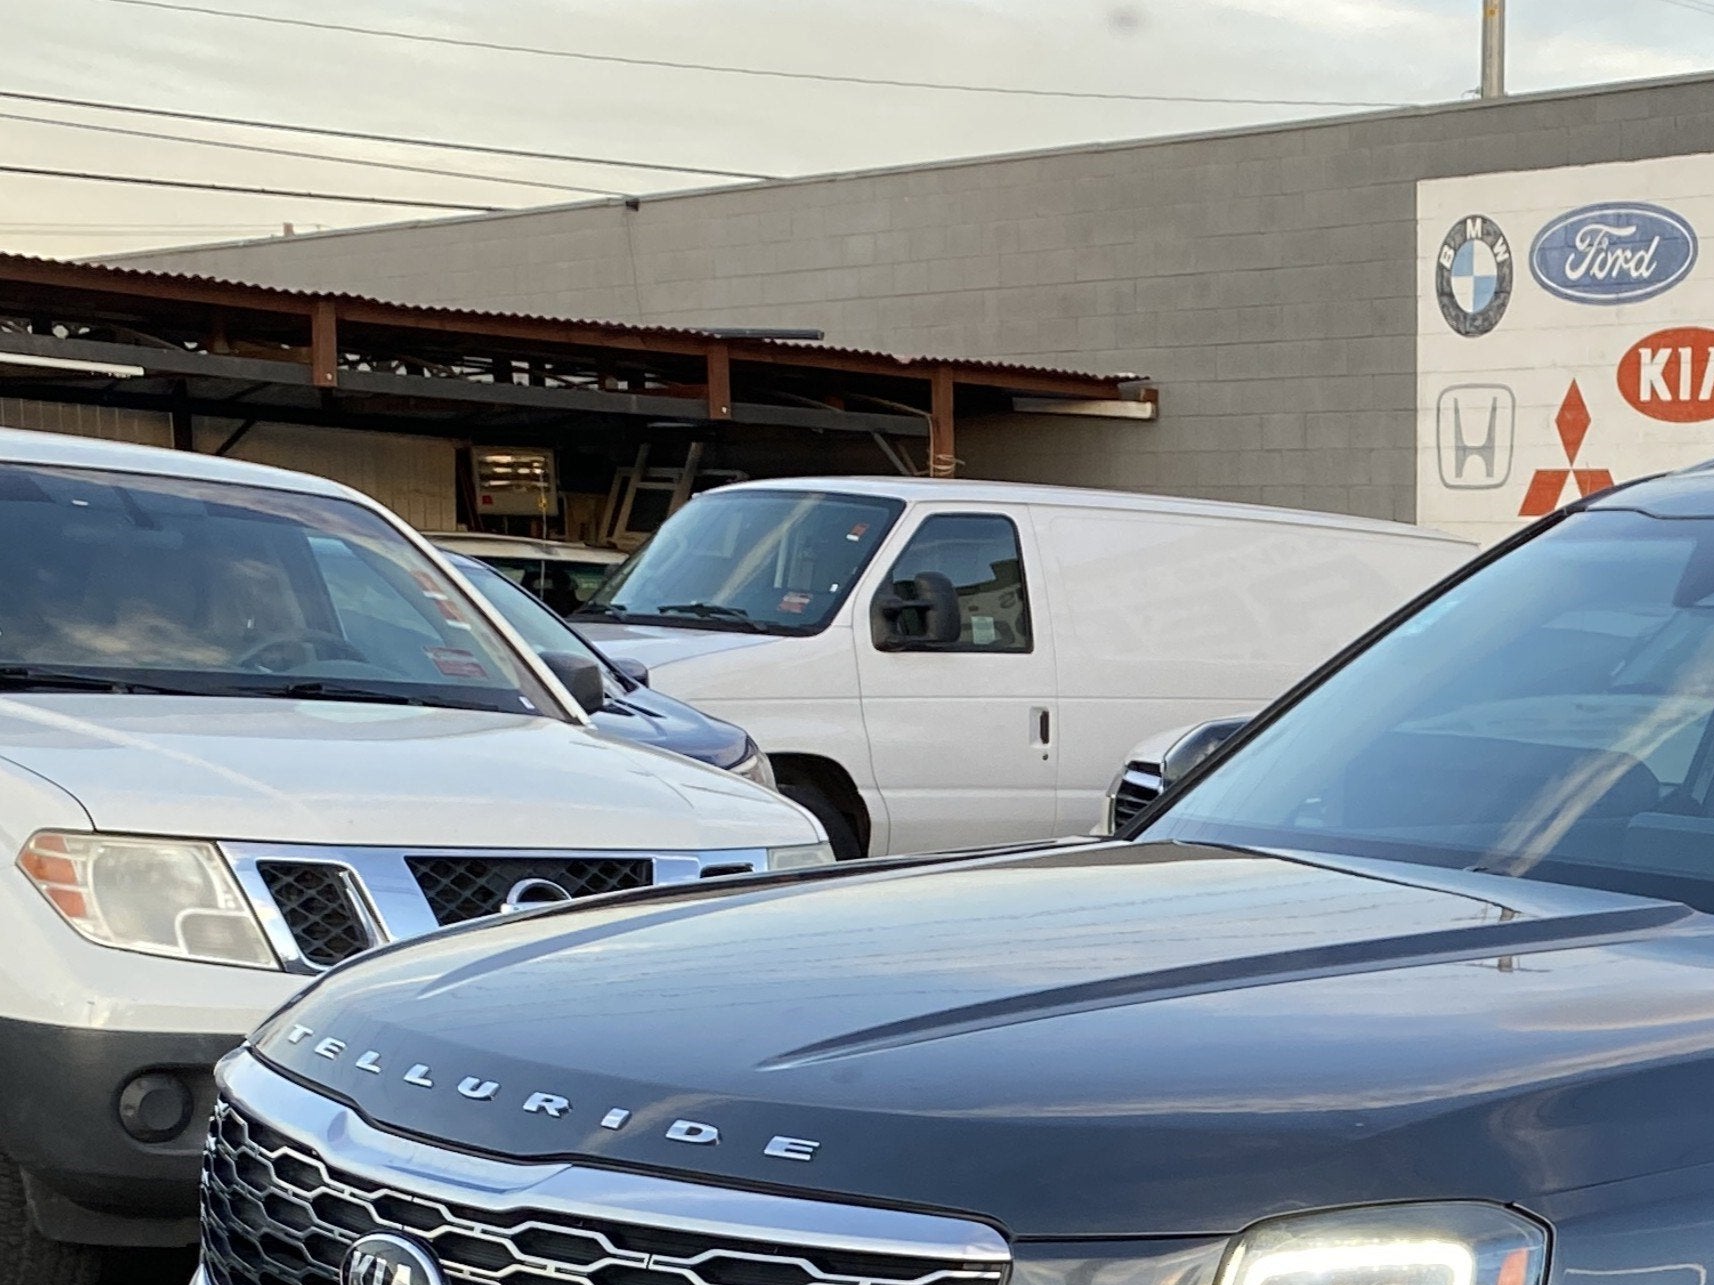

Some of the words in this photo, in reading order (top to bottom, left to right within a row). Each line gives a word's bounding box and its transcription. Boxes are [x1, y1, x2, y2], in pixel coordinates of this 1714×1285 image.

[1439, 217, 1510, 271] BMW
[1564, 223, 1660, 281] Ford
[287, 1023, 822, 1162] TELLURIDE
